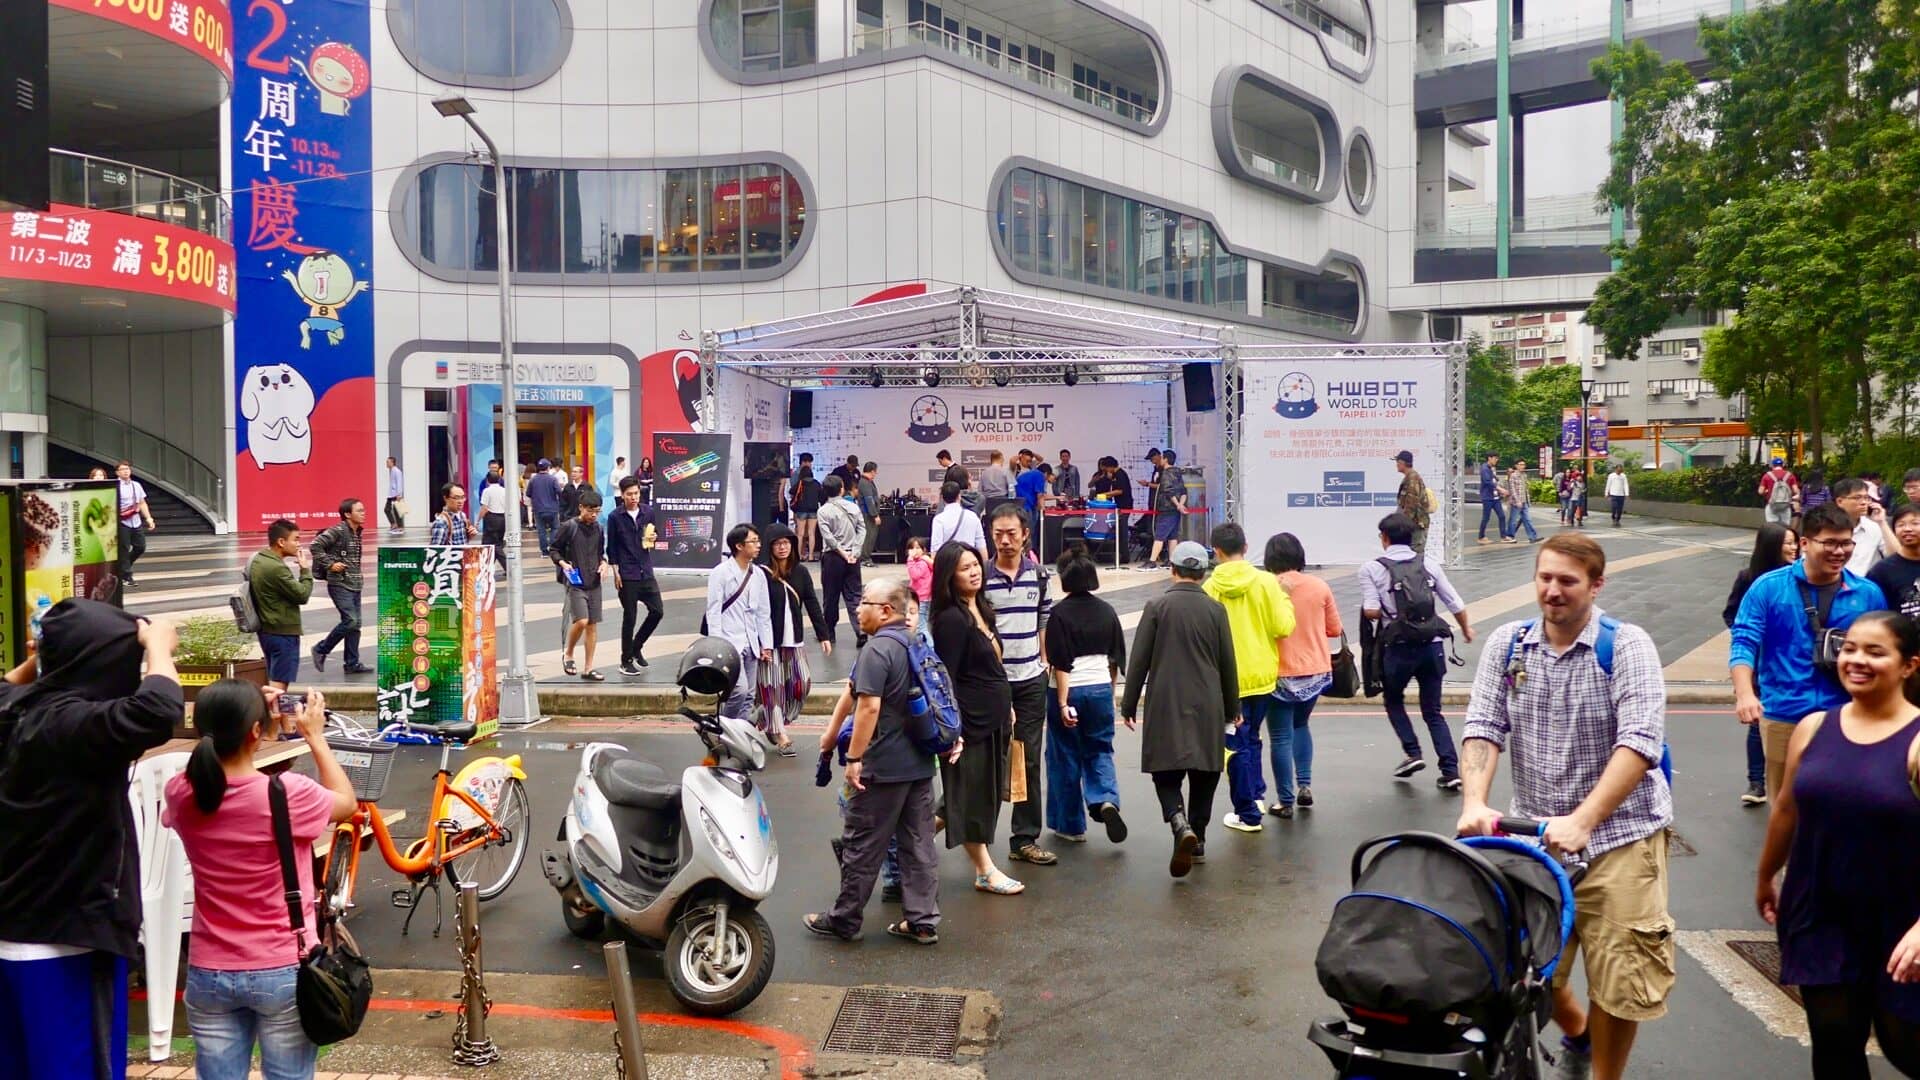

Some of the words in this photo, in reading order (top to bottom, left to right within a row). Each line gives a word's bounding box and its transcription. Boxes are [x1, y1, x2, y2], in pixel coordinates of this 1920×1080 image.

[169, 1, 189, 36] 送
[193, 6, 223, 57] 600
[10, 211, 92, 246] 第二波
[112, 238, 143, 275] 滿
[151, 235, 215, 288] 3,800
[516, 362, 597, 382] SYNTREND
[540, 388, 584, 401] SYNTREND
[1327, 381, 1417, 396] HWBOT
[1328, 398, 1378, 409] WORLD
[1382, 398, 1418, 409] TOUR
[961, 404, 1054, 420] HWBOT
[1339, 410, 1369, 419] TAIPEI
[1385, 410, 1407, 418] 2017
[962, 422, 1014, 433] WORLD
[1017, 421, 1054, 432] TOUR
[974, 434, 1003, 443] TAIPEI
[1021, 434, 1043, 442] 2017
